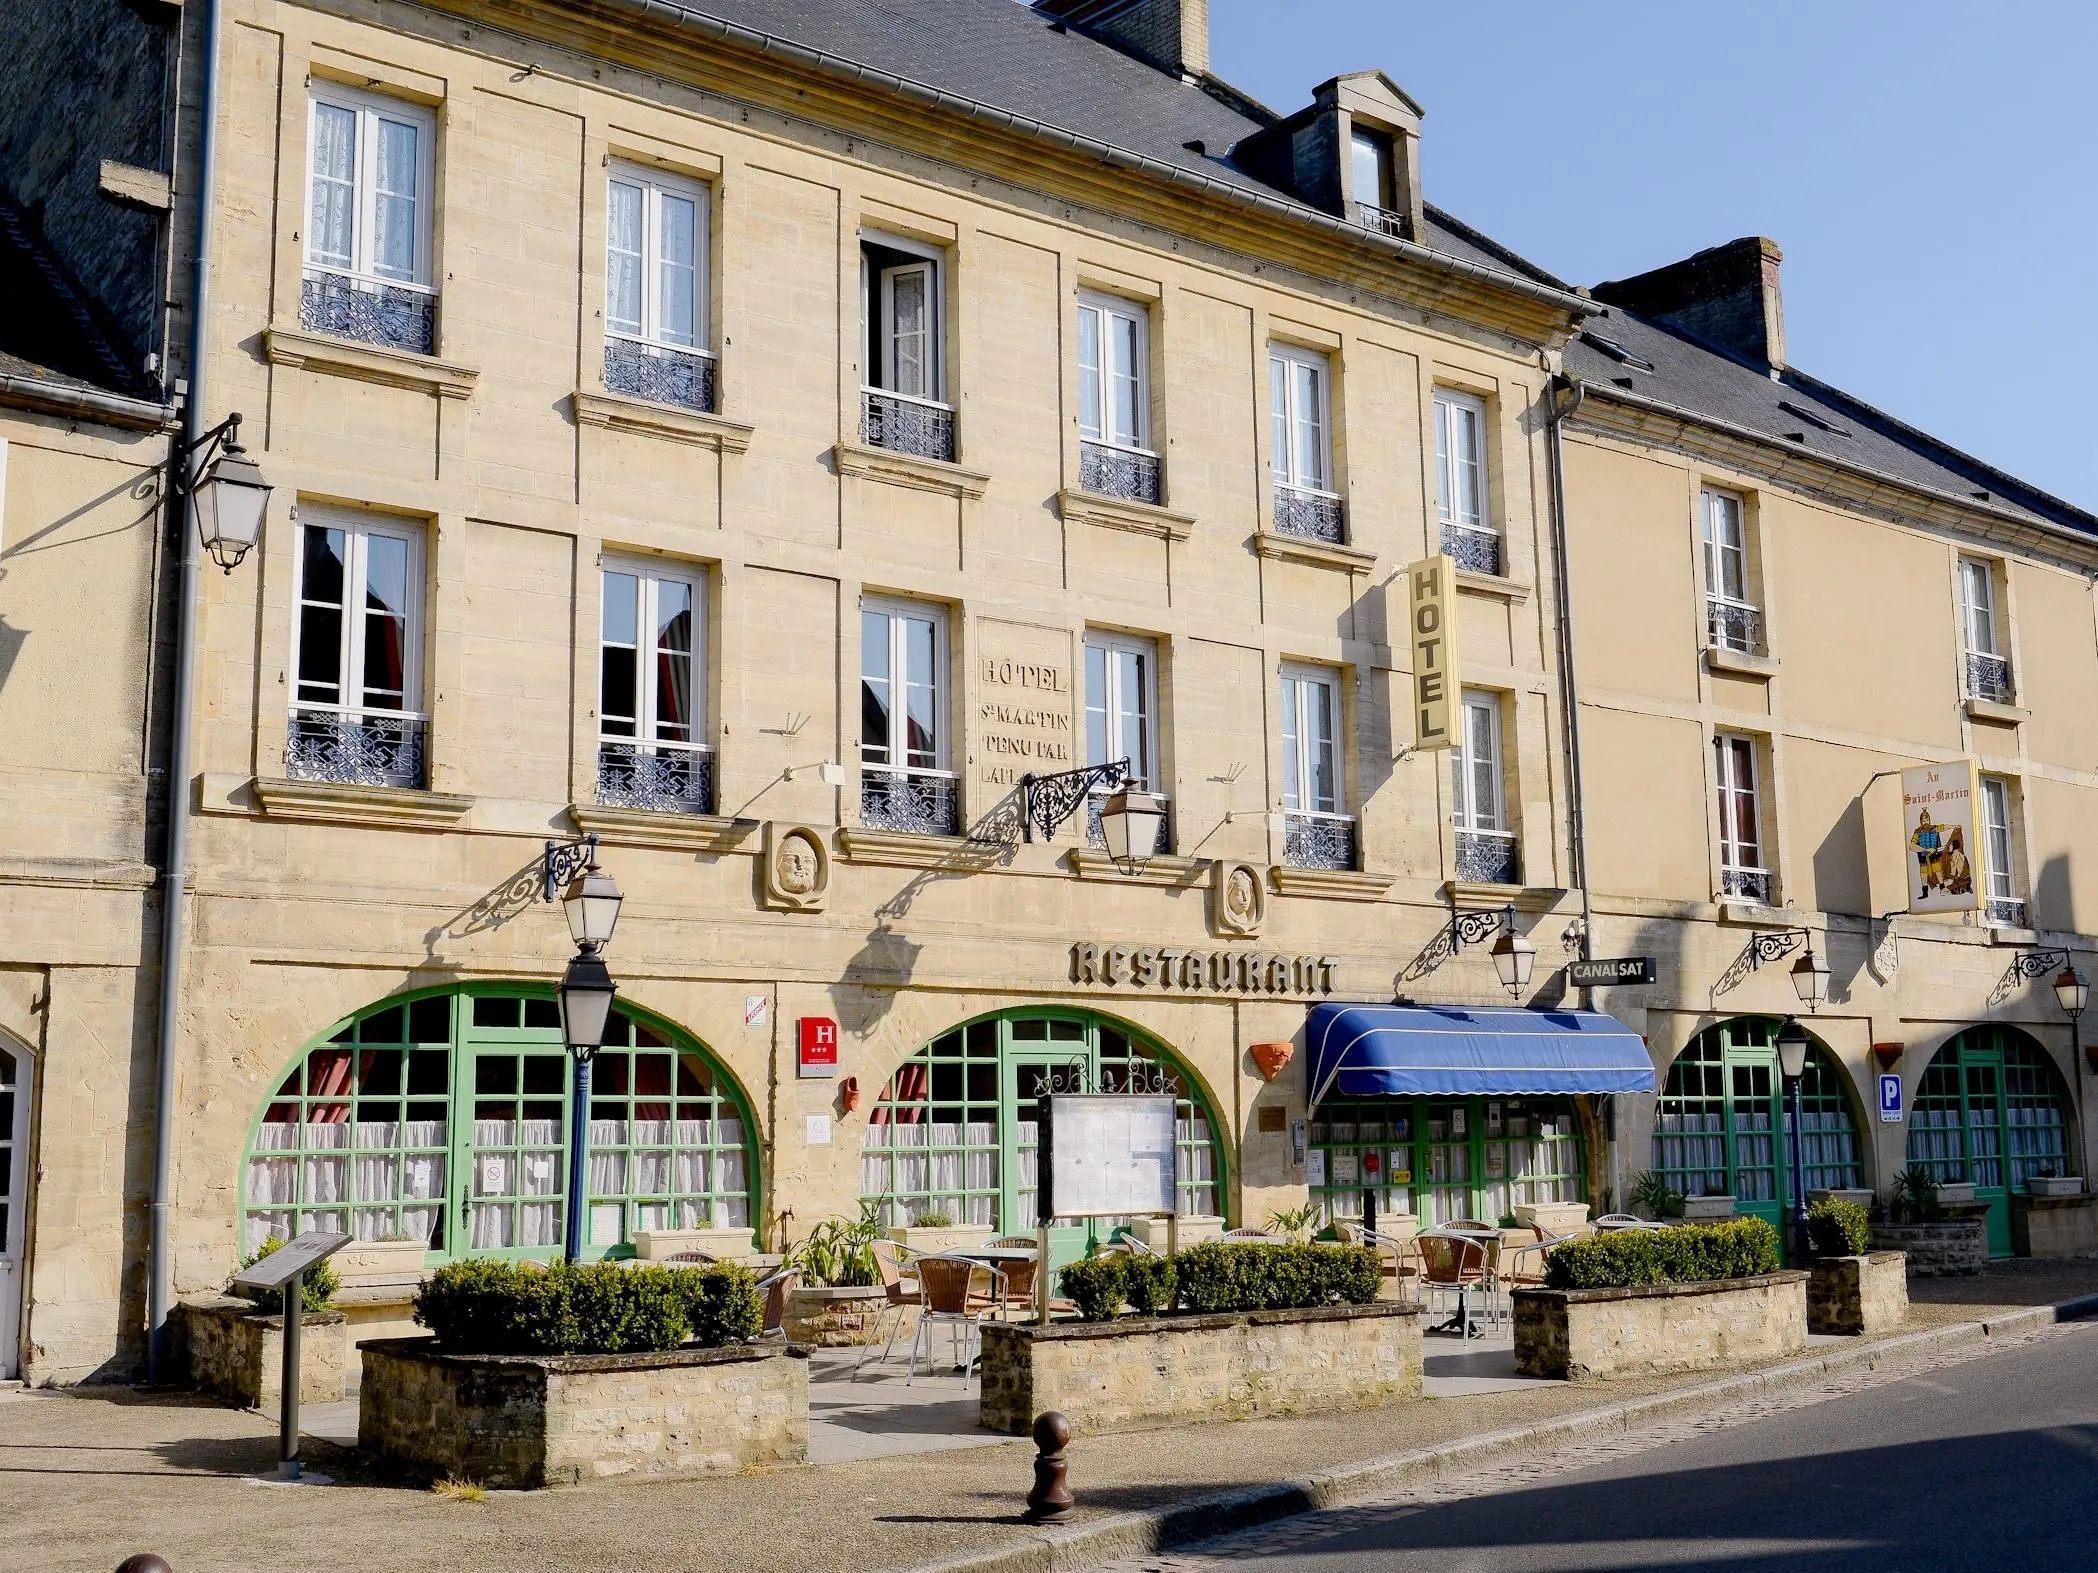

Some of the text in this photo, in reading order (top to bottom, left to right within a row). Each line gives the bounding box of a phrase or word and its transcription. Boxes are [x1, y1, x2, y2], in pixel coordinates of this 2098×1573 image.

[1415, 567, 1444, 738] HOTEL
[997, 705, 1068, 731] MARTIN
[983, 734, 1032, 756] TENU
[1903, 787, 1969, 806] Saint-Martin
[1068, 941, 1341, 997] RESTAURANT
[1573, 962, 1644, 978] CANALSAT
[815, 1025, 835, 1044] H
[1884, 1080, 1898, 1107] P
